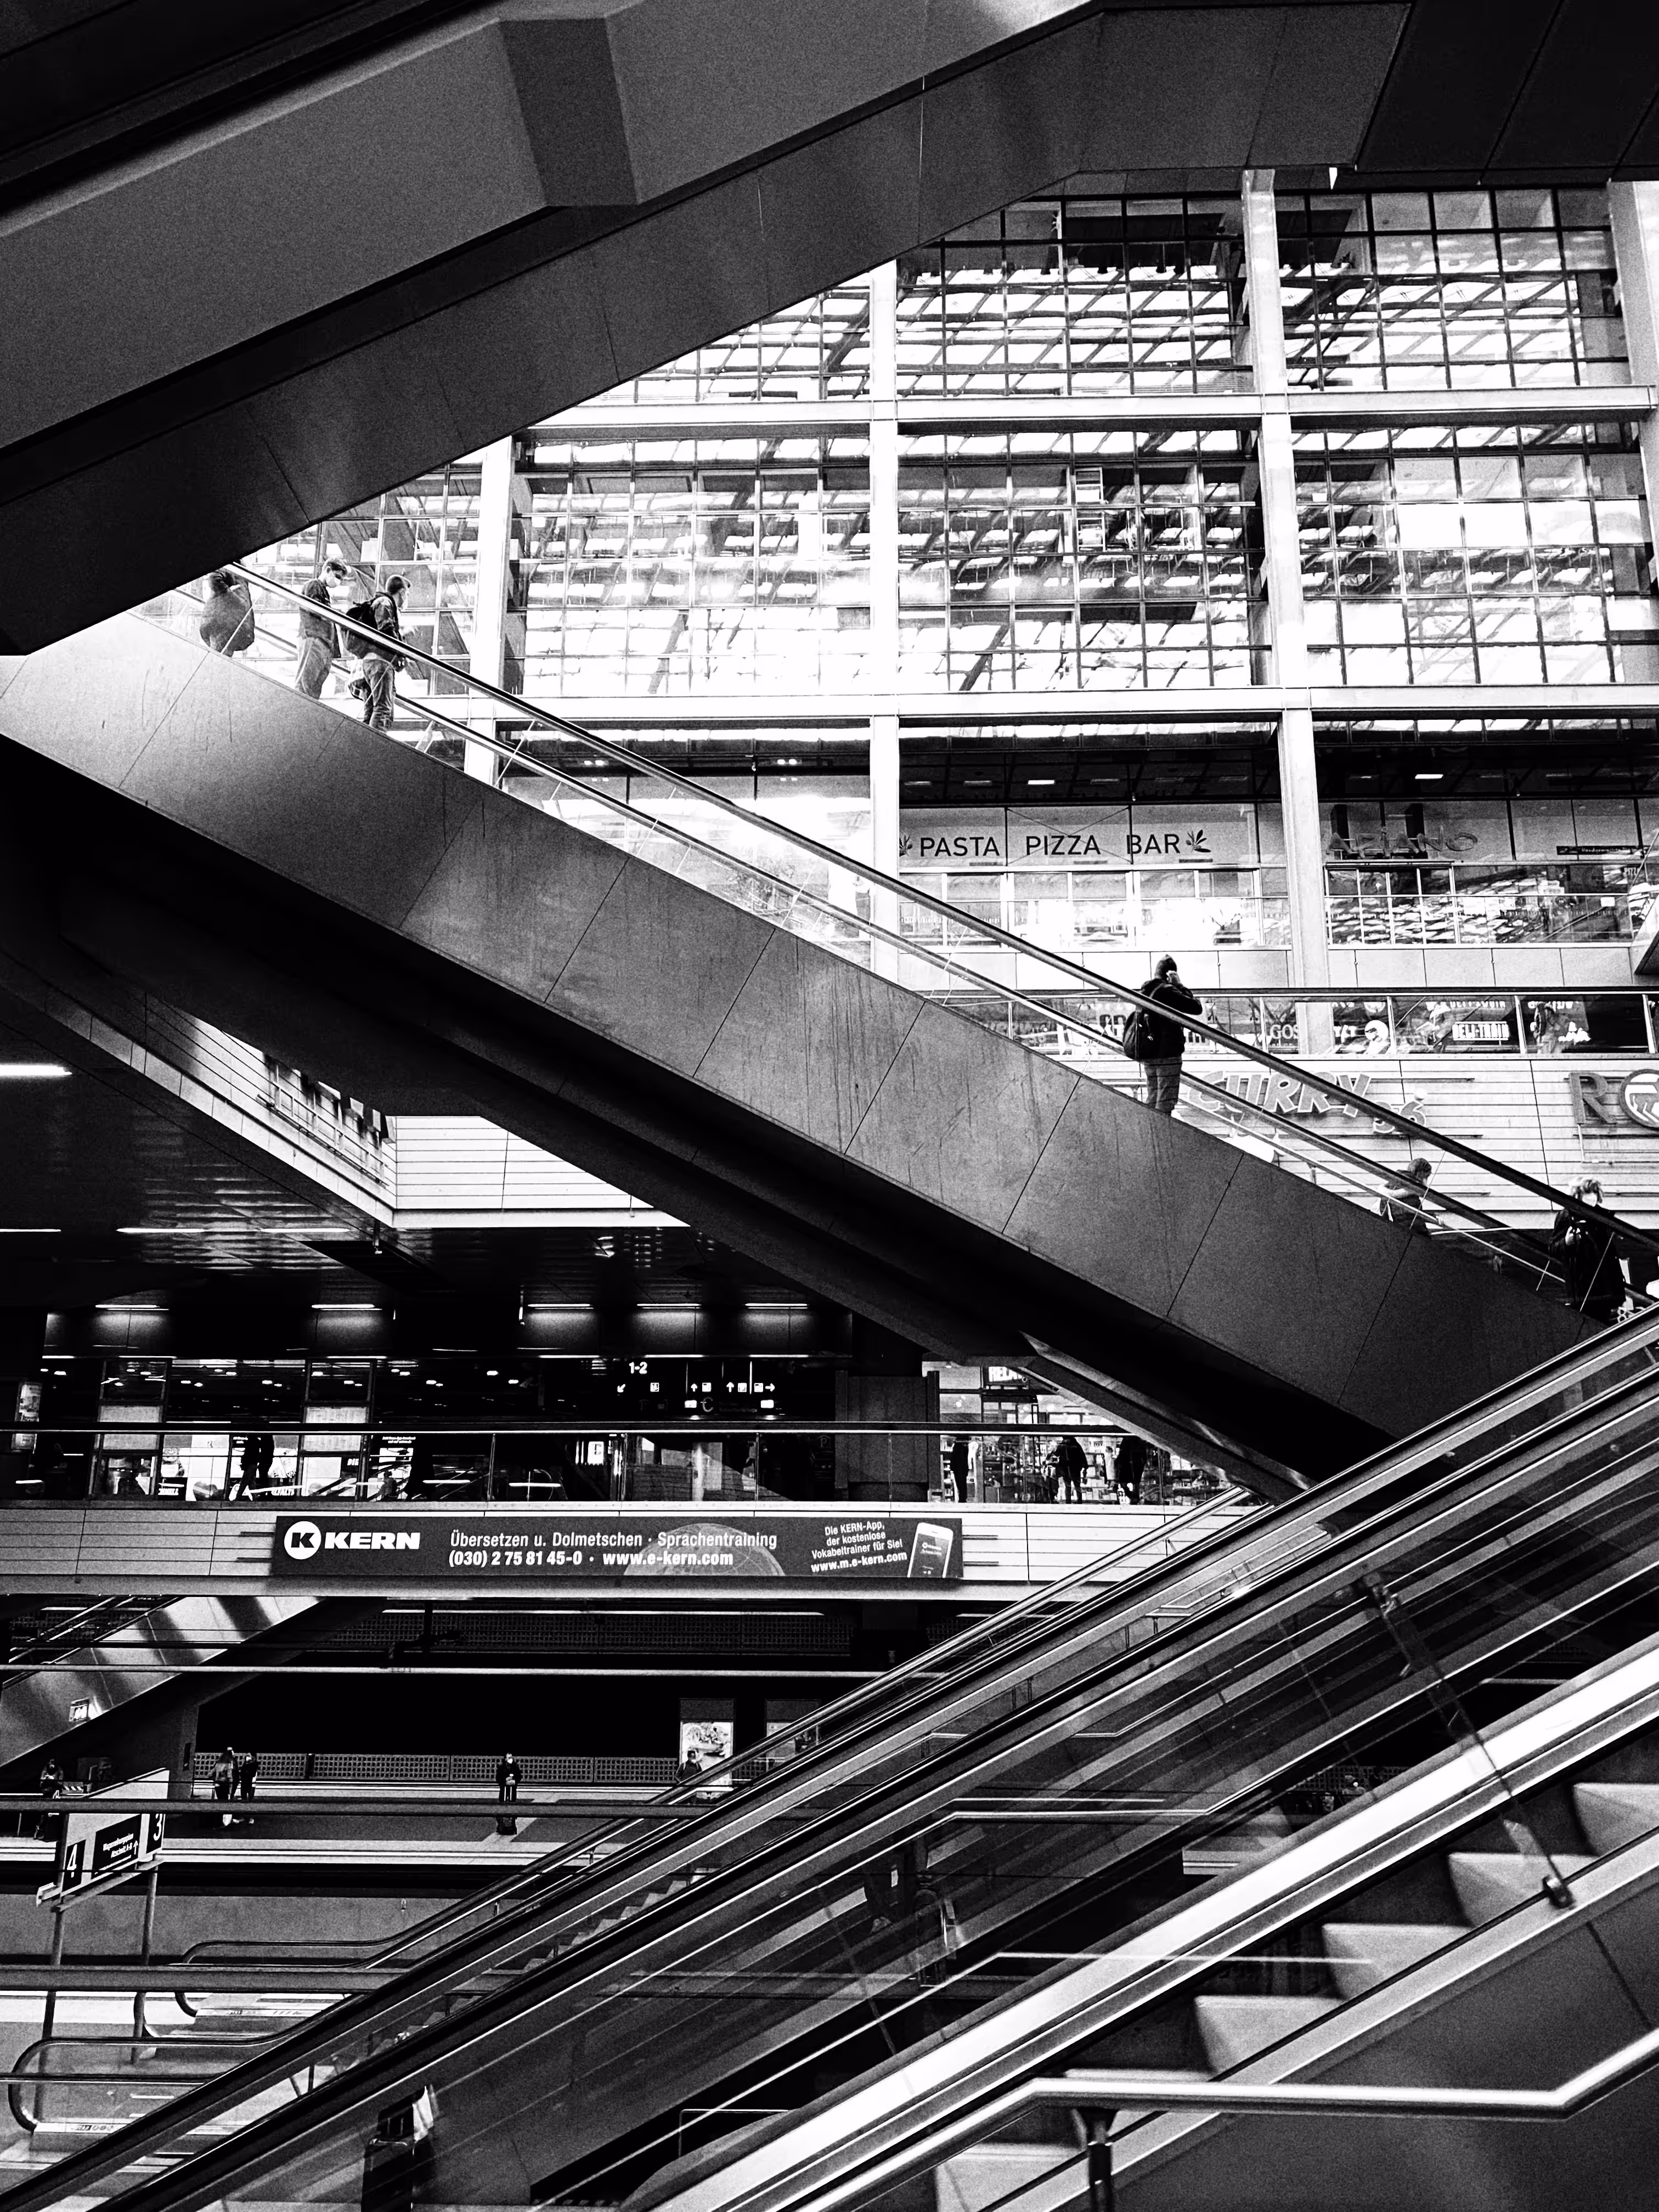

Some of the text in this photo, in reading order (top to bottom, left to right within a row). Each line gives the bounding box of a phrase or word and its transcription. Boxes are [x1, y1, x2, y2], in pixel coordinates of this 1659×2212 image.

[920, 833, 1181, 856] PASTA PIZZA BAR
[629, 1362, 647, 1374] 1-2
[989, 1366, 1022, 1382] RELA
[825, 1521, 885, 1536] Die KERN-App,
[324, 1532, 421, 1549] KERN
[450, 1529, 777, 1549] Übersetzen u. Dolmetschen Sprachentraining
[826, 1532, 886, 1547] der kostenlose
[449, 1550, 488, 1567] (030)
[602, 1551, 733, 1565] www.e-kern.com
[811, 1544, 871, 1560] Vokabeltrainer
[873, 1541, 885, 1551] für
[810, 1551, 907, 1572] www.m.e-kern.com
[66, 1843, 77, 1878] 4
